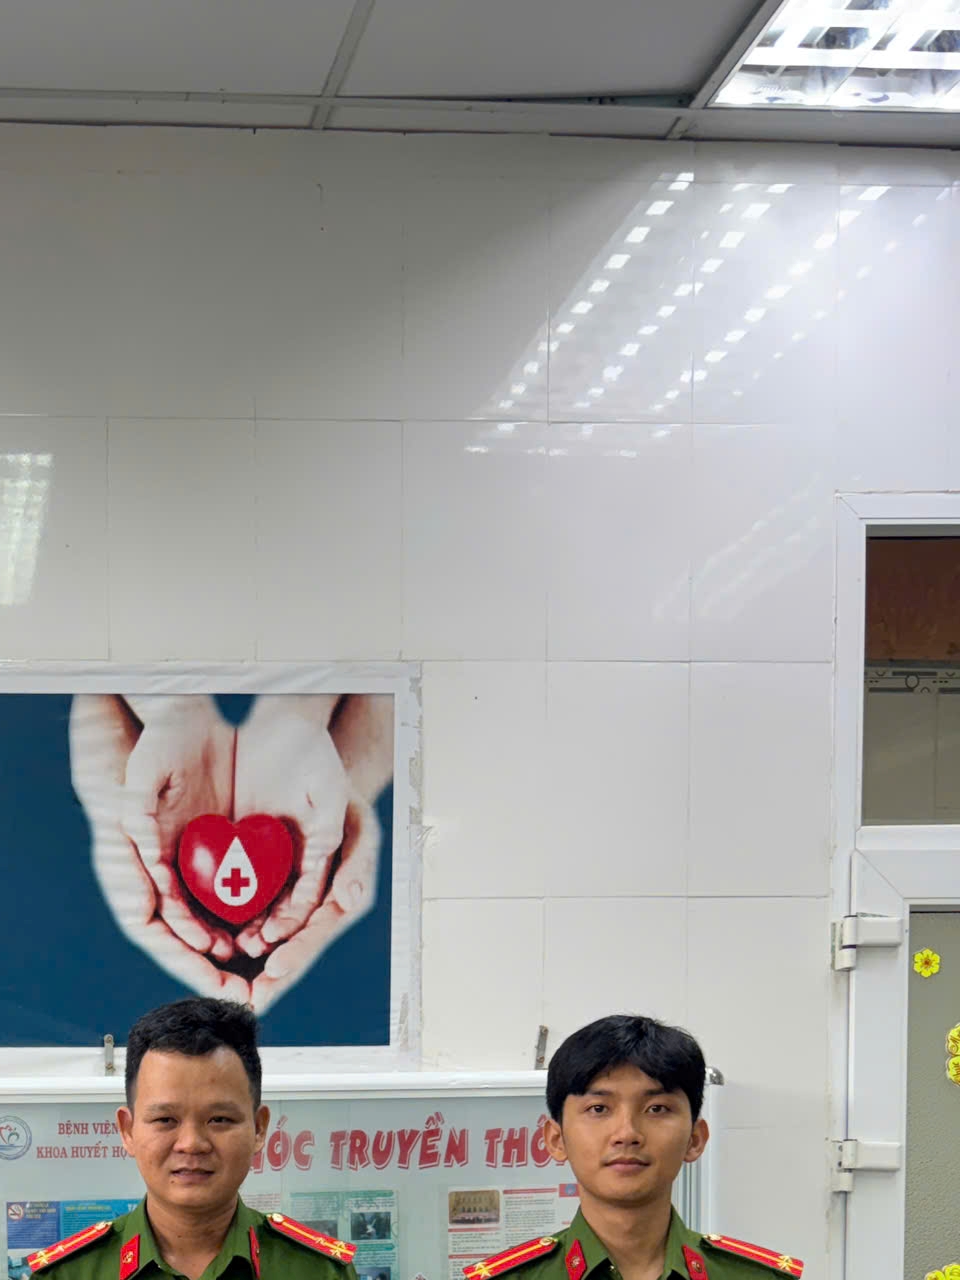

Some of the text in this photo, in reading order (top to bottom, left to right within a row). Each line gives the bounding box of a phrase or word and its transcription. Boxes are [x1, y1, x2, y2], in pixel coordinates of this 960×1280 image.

[58, 1120, 119, 1138] BỆNH VIỆN
[36, 1141, 135, 1160] KHOA HUYẾT HỌ
[330, 1112, 469, 1171] TRUYỀN
[484, 1114, 566, 1169] THÔ
